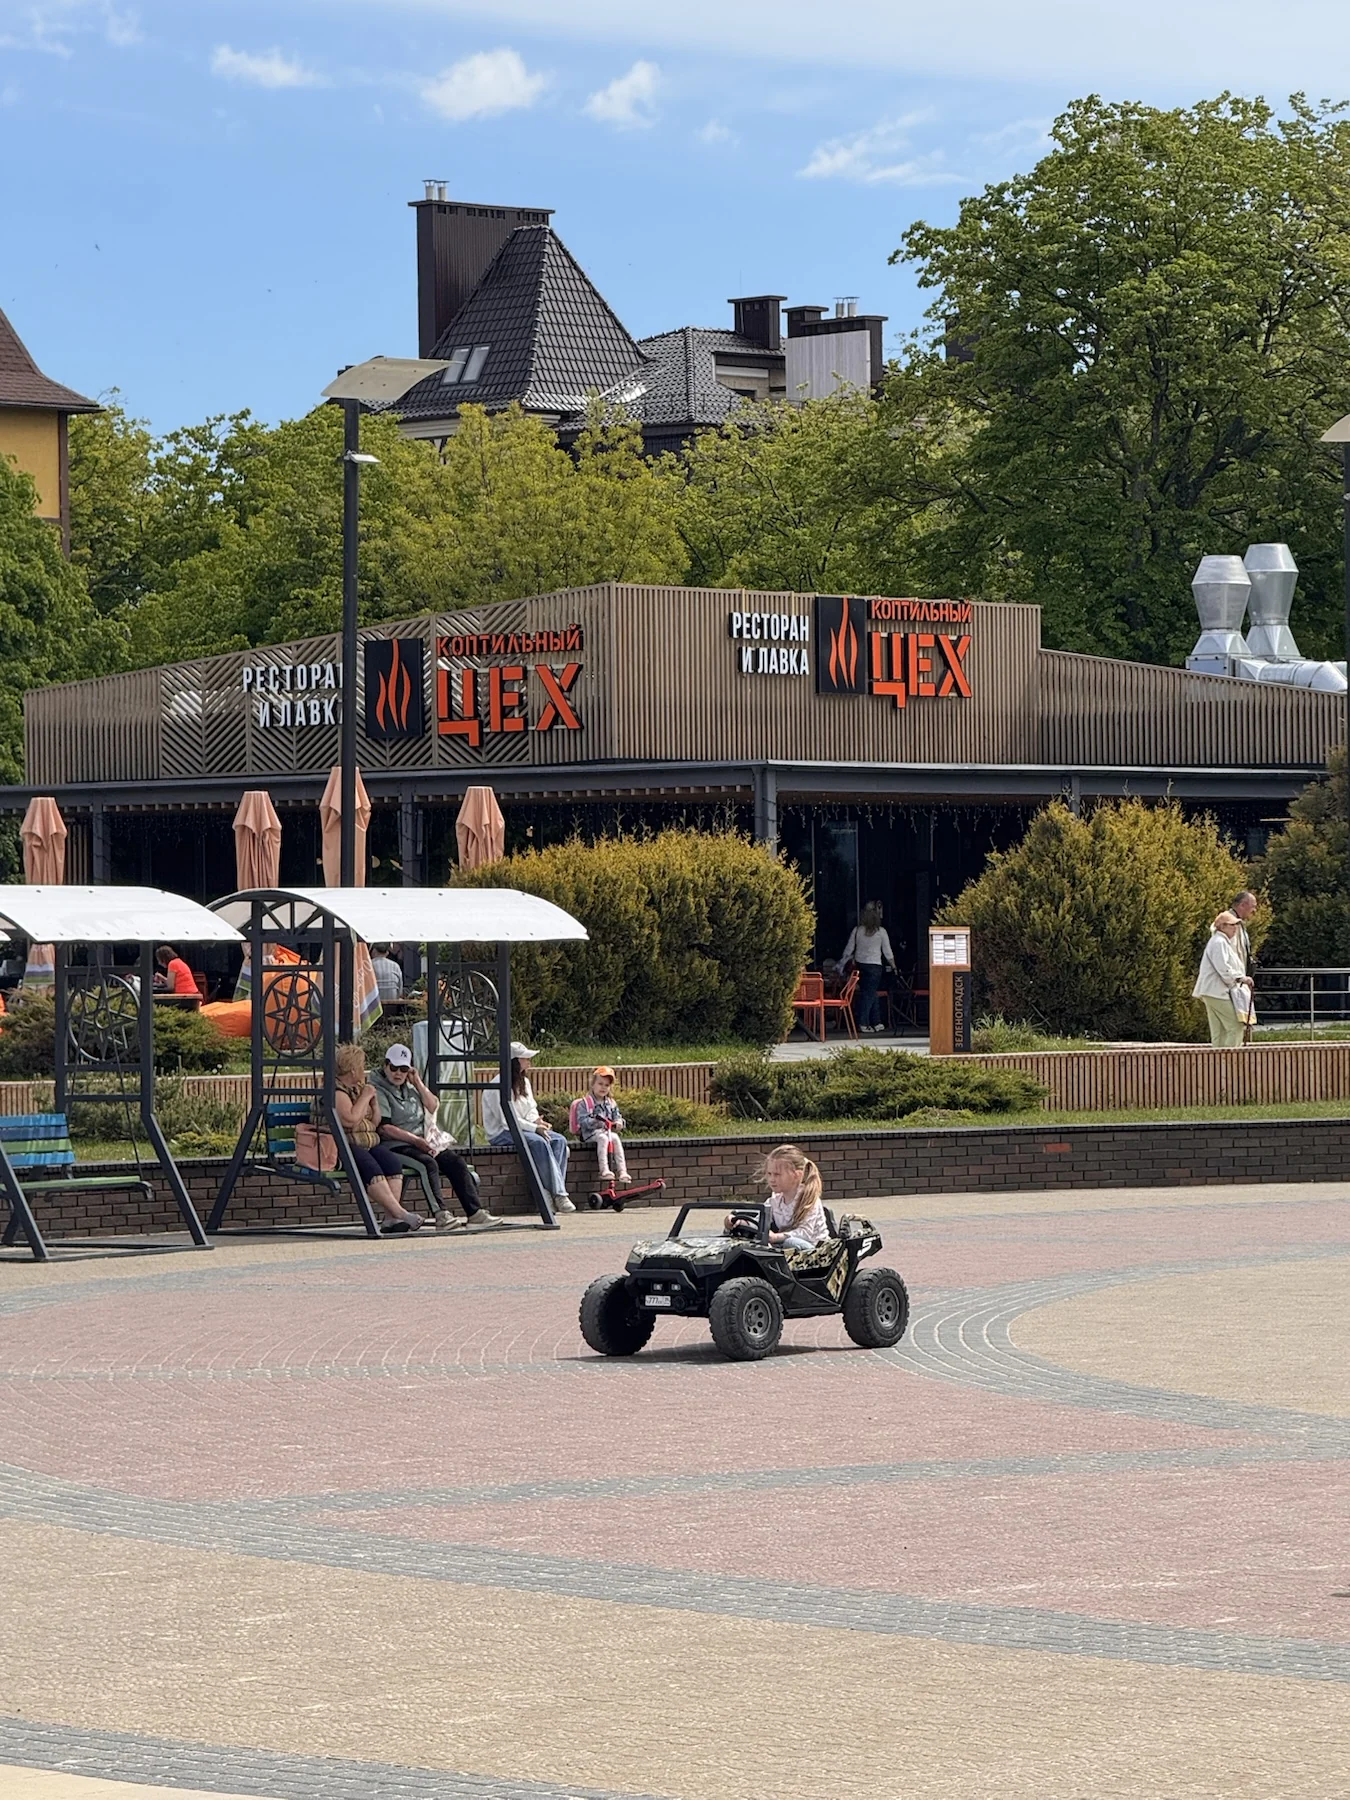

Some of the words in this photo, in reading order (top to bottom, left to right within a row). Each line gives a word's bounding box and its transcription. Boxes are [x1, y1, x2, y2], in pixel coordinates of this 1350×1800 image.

[871, 598, 972, 623] КОПТИЛЬНЫЙ
[436, 623, 581, 657] КОПТИЛЬНЫЙ
[732, 612, 809, 642] РЕСТОРАН
[742, 646, 753, 673] И
[757, 647, 810, 676] ЛАВКА
[872, 632, 972, 708] ЦЕХ
[260, 701, 271, 728] И
[280, 698, 343, 727] ЛАВК
[437, 662, 581, 747] ЦЕХ
[954, 975, 965, 1048] ЗЕЛЕНОГРАДСК
